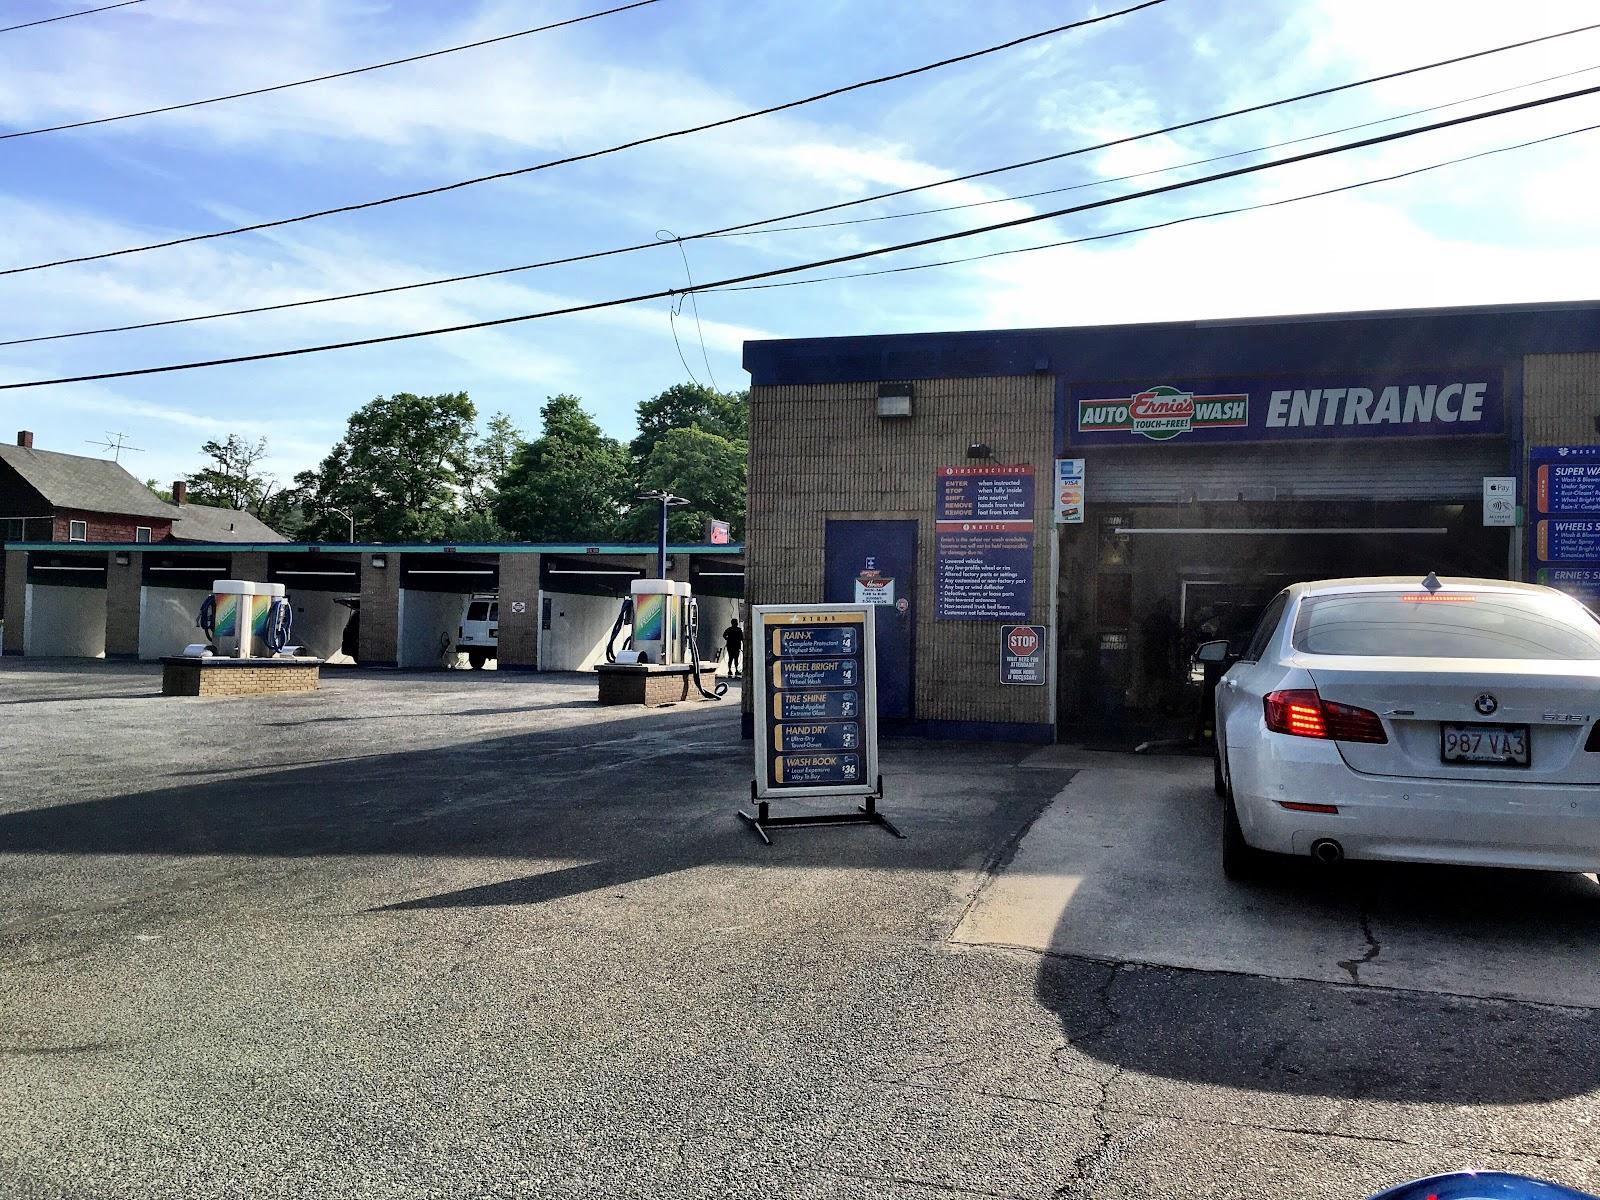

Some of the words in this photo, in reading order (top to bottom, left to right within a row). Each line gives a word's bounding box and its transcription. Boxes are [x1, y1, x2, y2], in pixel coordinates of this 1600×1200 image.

[1082, 406, 1128, 424] AUTO
[1130, 392, 1194, 419] Ernie's
[1196, 402, 1245, 420] WASH
[1266, 382, 1487, 428] ENTRANCE
[1135, 419, 1189, 429] TOUCH-FREE!
[1555, 467, 1585, 476] SUPER
[1497, 484, 1510, 492] Pay
[1555, 522, 1593, 531] WHEELS
[1555, 571, 1590, 579] ERNIE'S
[783, 631, 812, 640] RAIN-X
[842, 638, 851, 647] $4
[1010, 635, 1035, 647] STOP
[784, 663, 810, 671] WHEEL
[811, 662, 839, 671] BRIGHT
[842, 670, 851, 678] $4
[785, 695, 801, 703] TIRE
[802, 694, 827, 702] SHINE
[785, 726, 811, 735] HAND
[812, 726, 828, 734] DRY
[1447, 733, 1482, 753] 987
[1489, 733, 1525, 755] VA3
[786, 758, 811, 767] WASH
[812, 757, 837, 766] BOOK
[842, 764, 856, 774] $36
